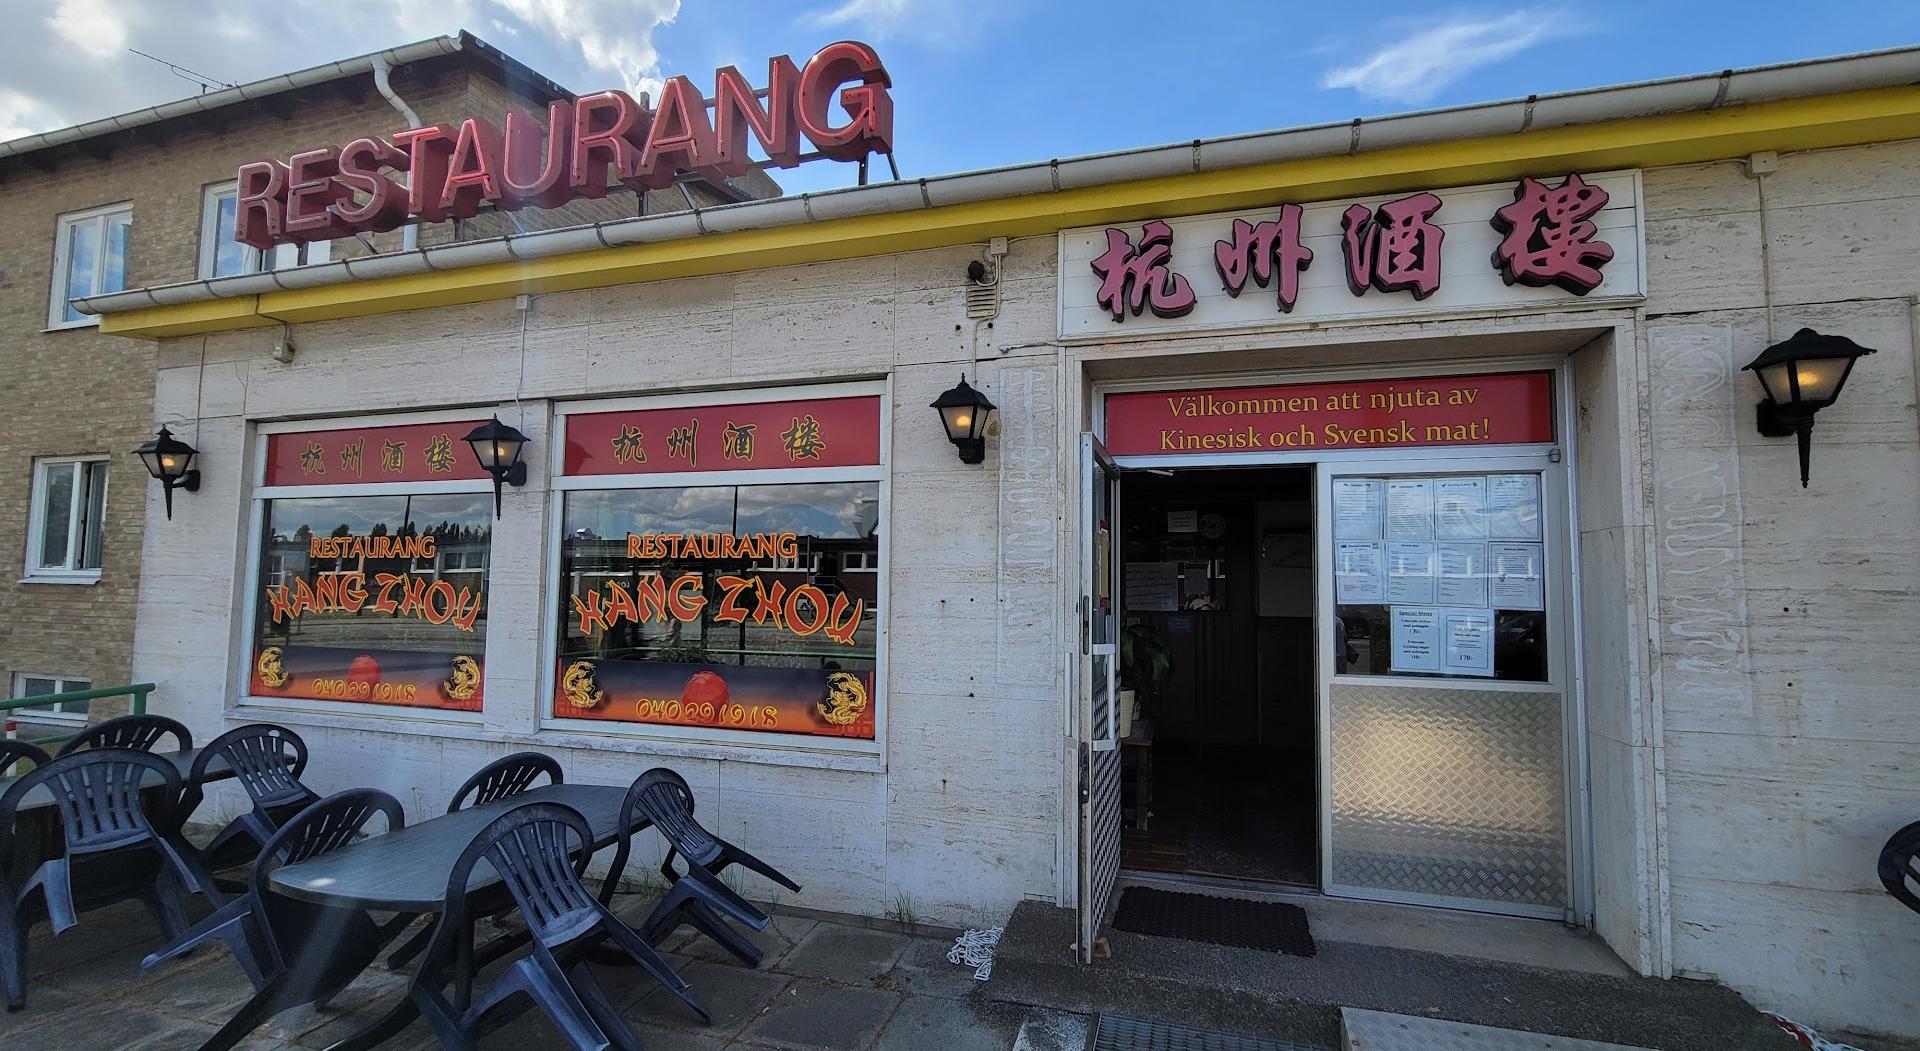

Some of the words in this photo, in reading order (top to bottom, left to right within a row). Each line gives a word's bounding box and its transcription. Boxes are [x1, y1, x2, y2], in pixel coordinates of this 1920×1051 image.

[235, 41, 893, 248] RESTAURANG
[1090, 171, 1615, 323] 杭州酒樓
[1168, 393, 1319, 417] Välkommen
[1325, 391, 1361, 411] att
[1370, 386, 1441, 414] njuta
[1448, 389, 1480, 405] av
[1160, 427, 1262, 450] Kinesisk
[1269, 424, 1316, 448] och
[1324, 420, 1416, 445] Svensk
[1425, 418, 1490, 441] mat!
[310, 536, 436, 559] RESTAURANG
[627, 533, 798, 559] RESTAURANG
[267, 572, 368, 624] HANG
[372, 572, 481, 632] ZHOU
[572, 575, 708, 635] HANG
[714, 575, 863, 646] ZHOU
